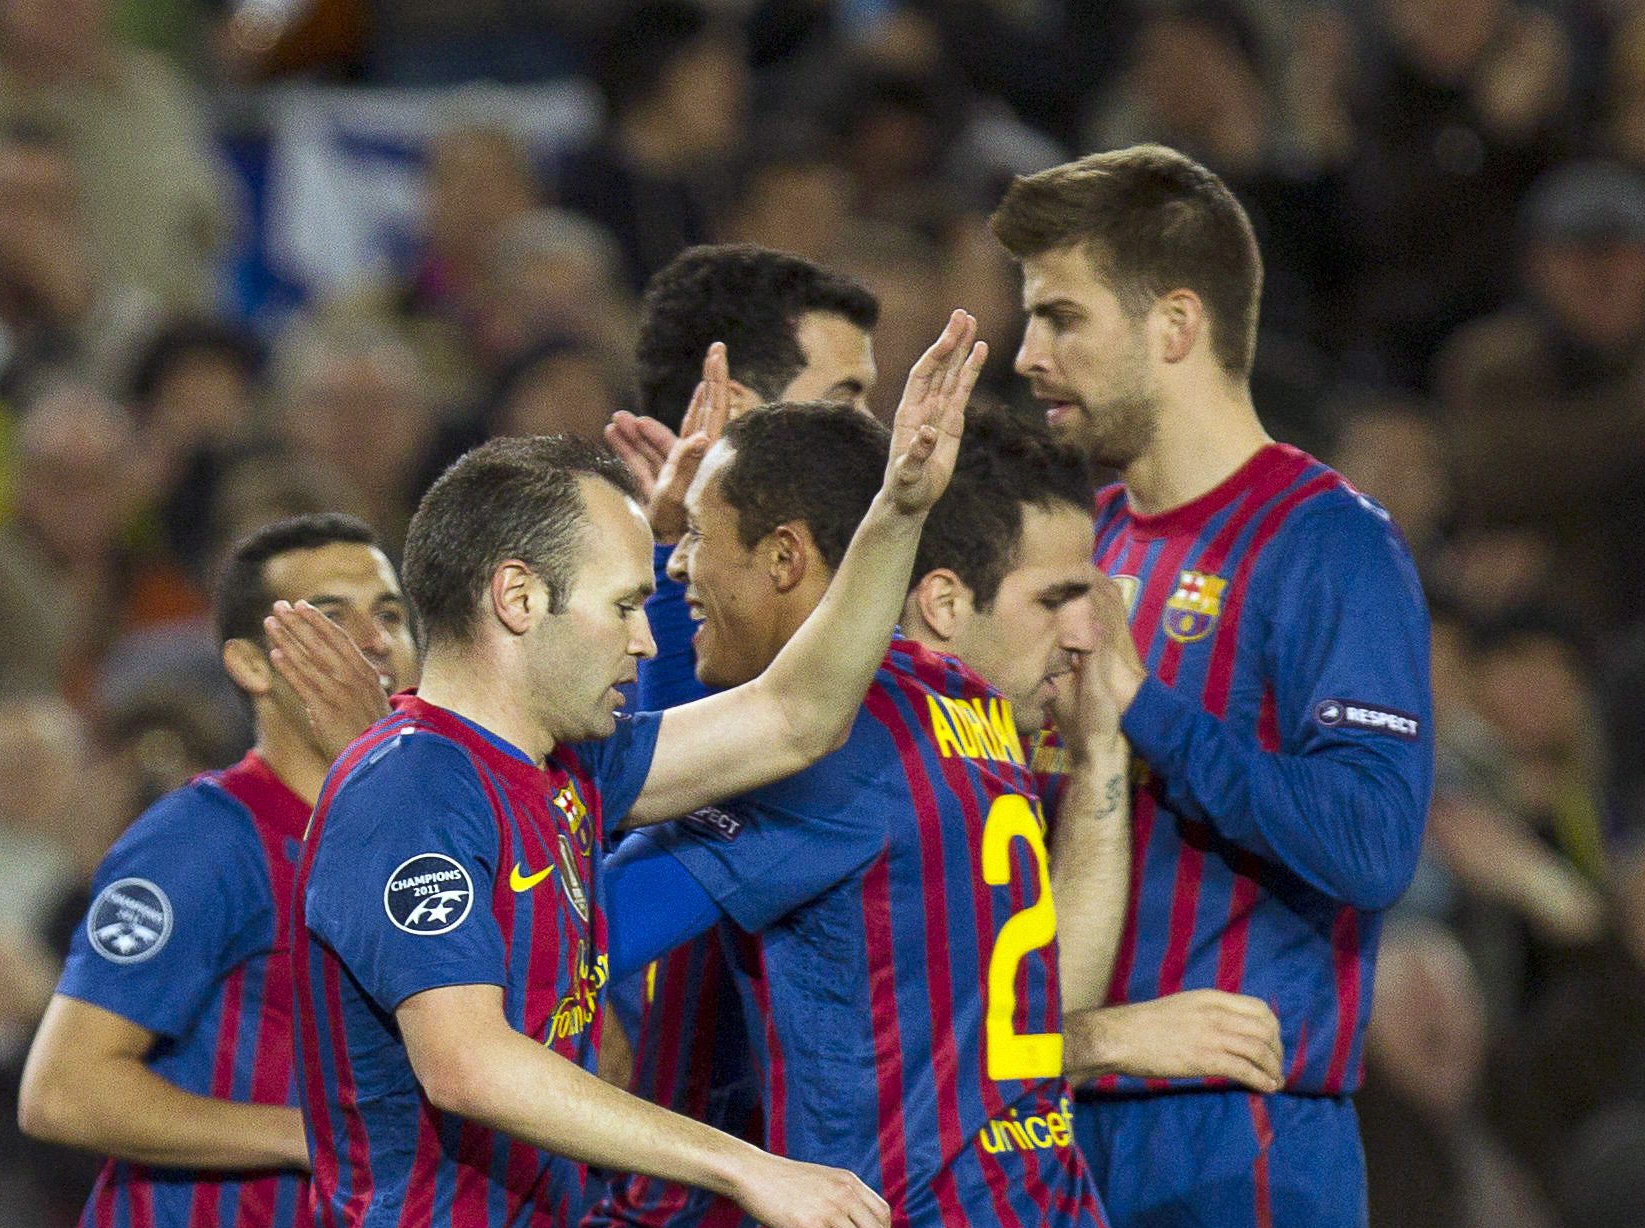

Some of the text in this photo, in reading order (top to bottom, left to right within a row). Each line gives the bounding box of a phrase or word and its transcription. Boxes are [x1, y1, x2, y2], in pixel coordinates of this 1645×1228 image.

[1345, 706, 1418, 736] RESPECT
[390, 869, 462, 892] CHAMPIONS
[413, 884, 440, 897] 2011
[979, 1098, 1074, 1154] unicef
